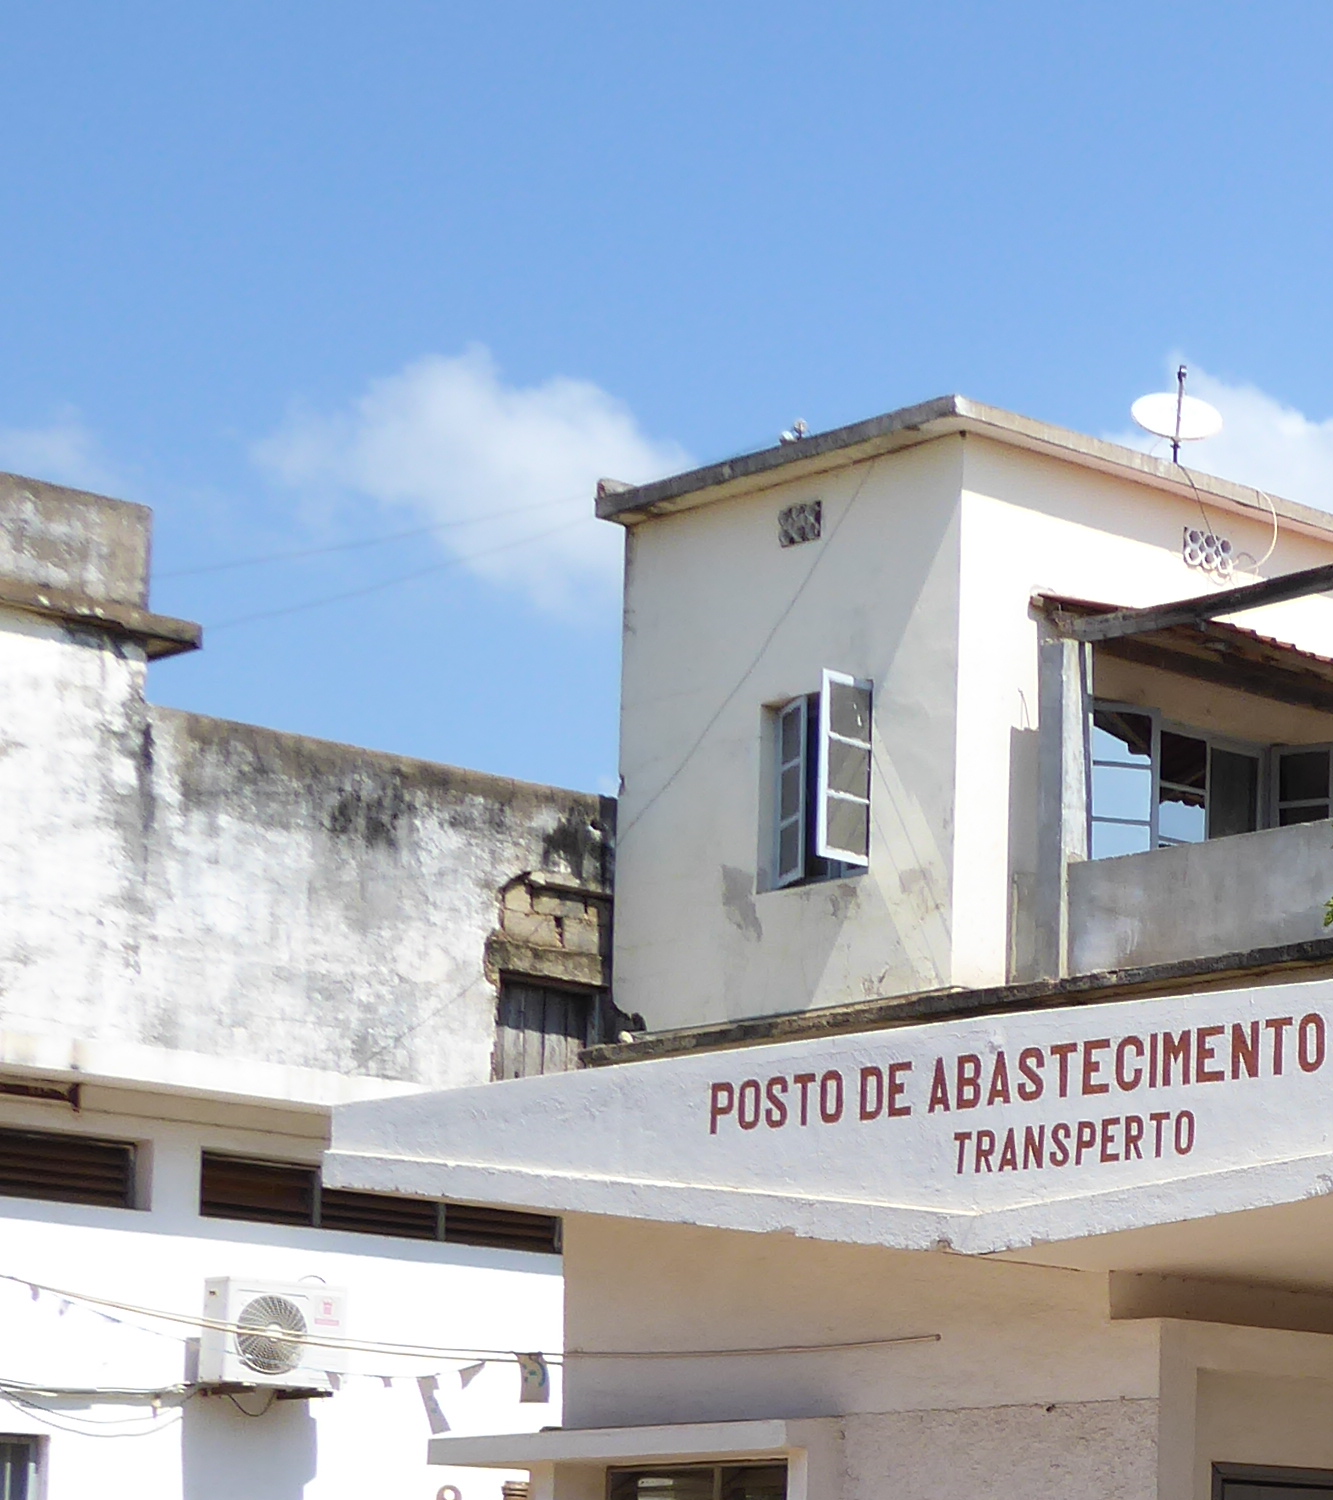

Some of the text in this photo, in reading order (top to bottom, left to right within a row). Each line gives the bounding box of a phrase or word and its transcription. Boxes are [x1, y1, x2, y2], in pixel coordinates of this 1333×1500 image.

[709, 1071, 845, 1135] POSTO
[859, 1063, 912, 1119] DE
[927, 1012, 1326, 1112] ABASTECIMENTO
[953, 1110, 1196, 1174] TRANSPERTO
